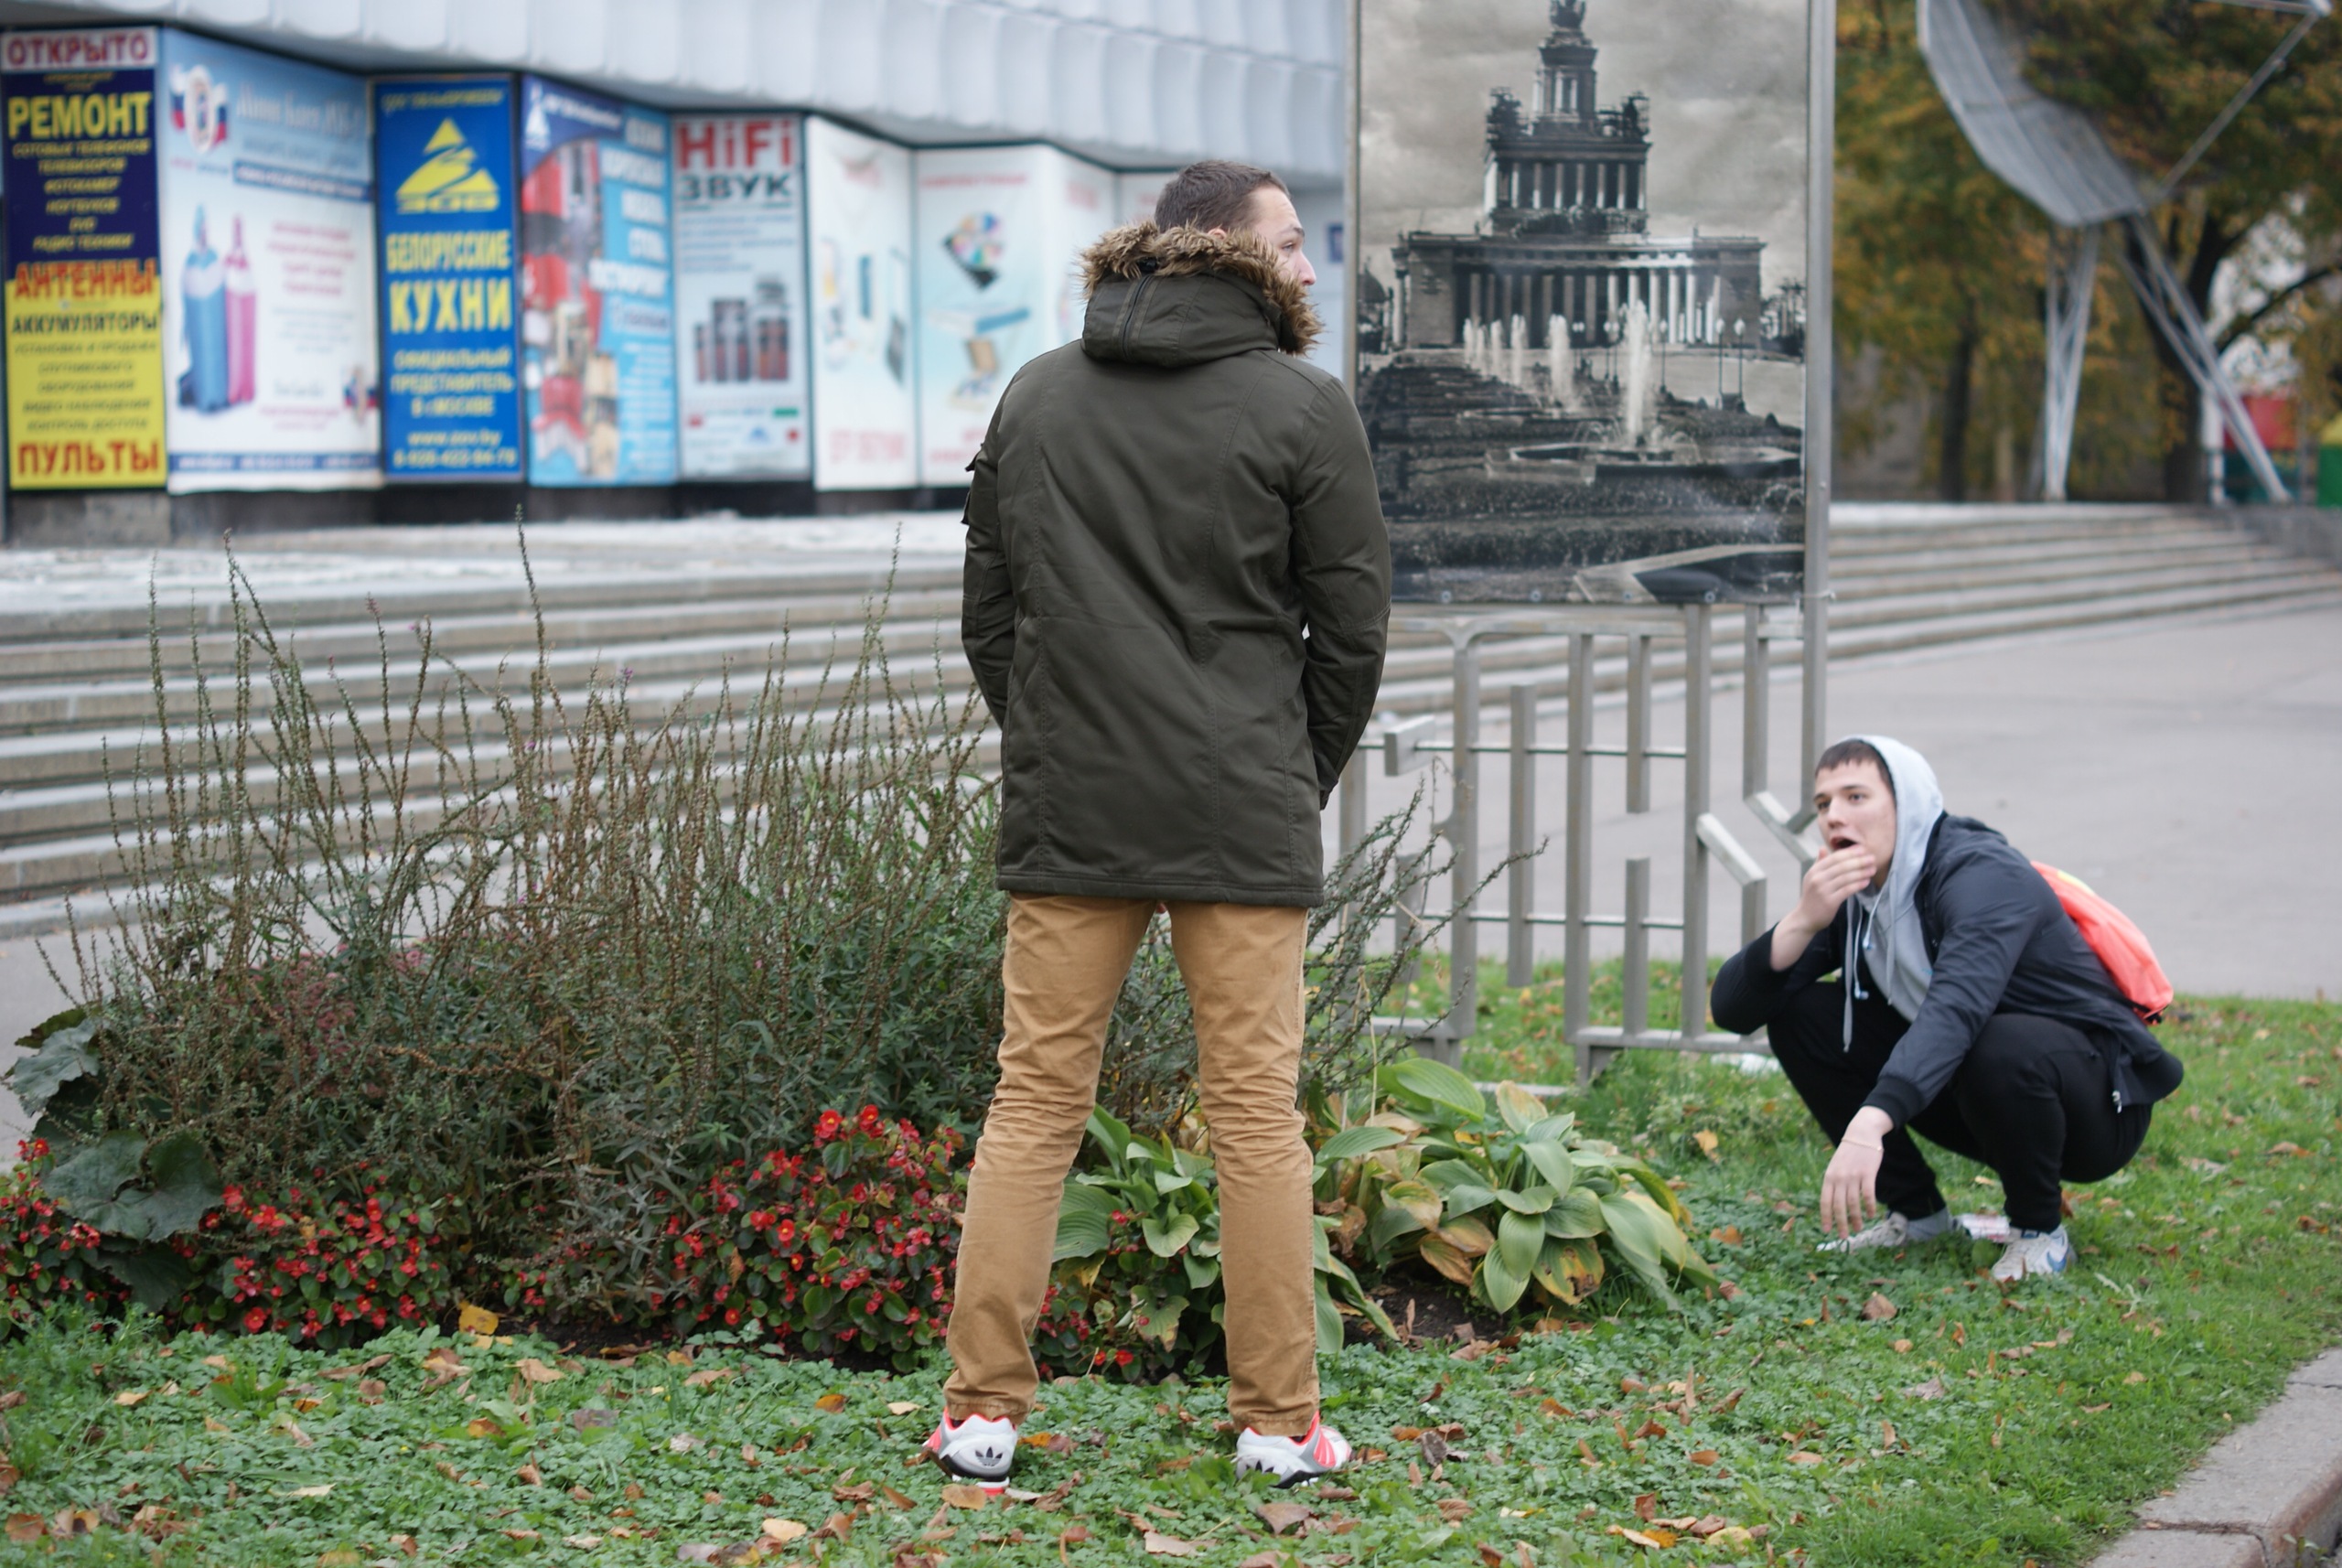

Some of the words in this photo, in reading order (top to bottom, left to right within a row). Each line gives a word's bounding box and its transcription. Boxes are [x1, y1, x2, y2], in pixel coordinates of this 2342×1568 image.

[7, 31, 148, 67] ОТКРЫТО
[7, 92, 152, 139] РЕМОНТ
[679, 120, 790, 170] HiFi
[680, 173, 791, 200] ЗВУК
[387, 231, 510, 272] БЕЛОРУССКИЕ
[16, 259, 156, 299] АНТЕННЫ
[13, 313, 157, 334] АККУМУЛЯТОРЫ
[391, 278, 511, 333] КУХНИ
[392, 372, 514, 393] ПРЕДСТАВИТЕЛЬ
[18, 441, 158, 475] ПУЛЬТЫ
